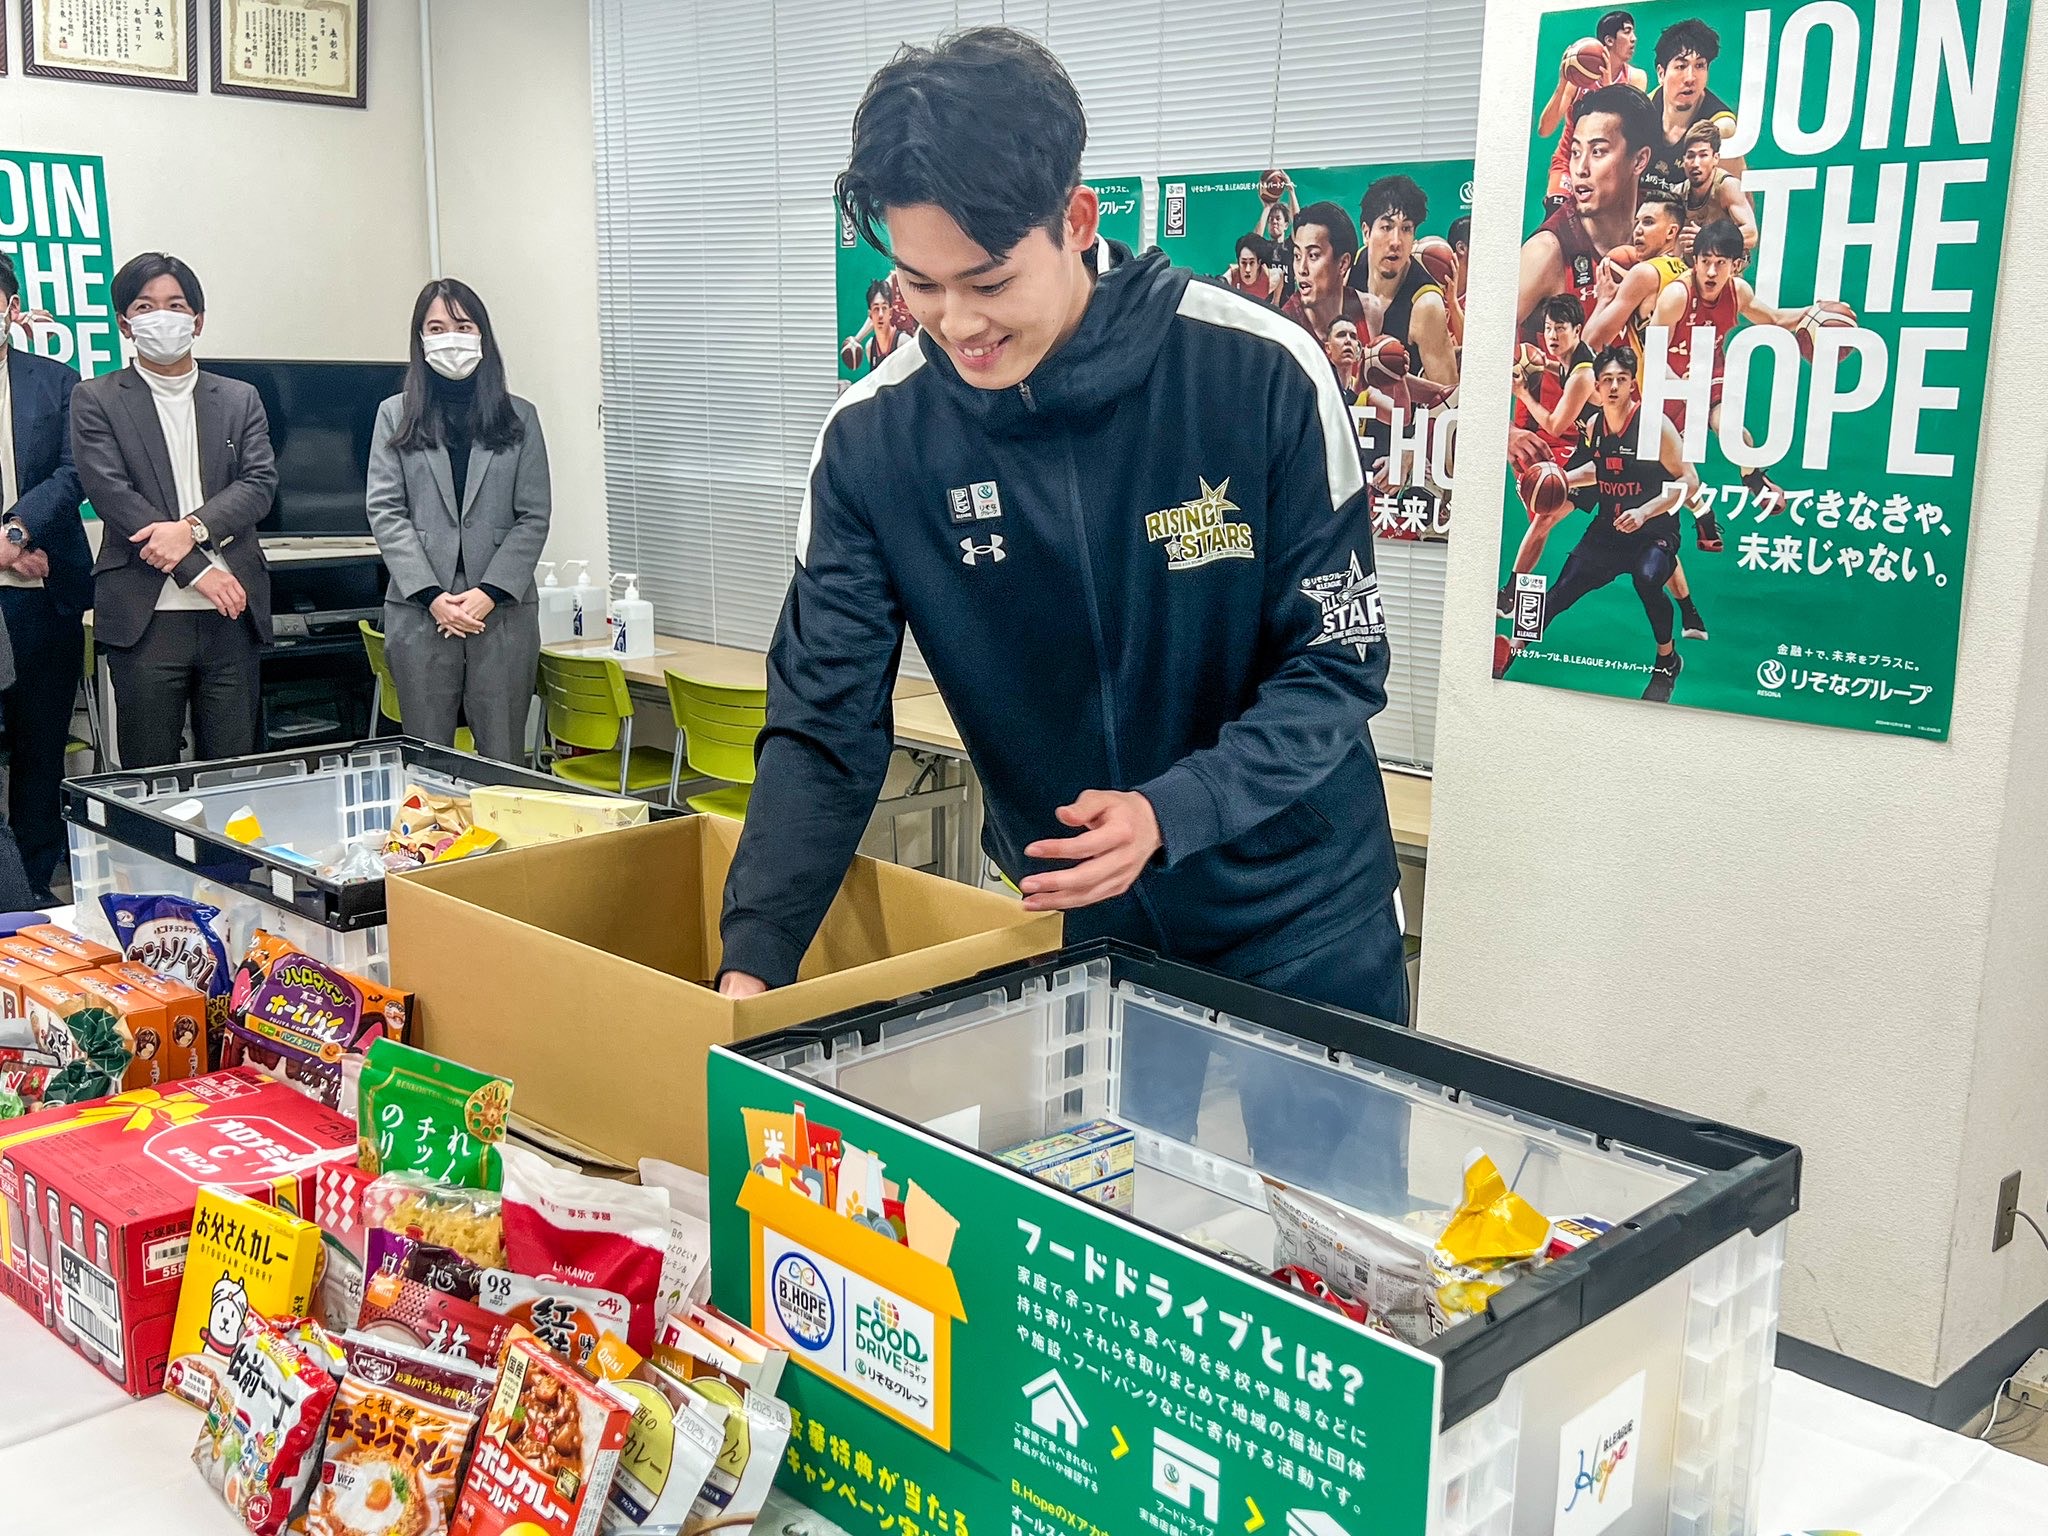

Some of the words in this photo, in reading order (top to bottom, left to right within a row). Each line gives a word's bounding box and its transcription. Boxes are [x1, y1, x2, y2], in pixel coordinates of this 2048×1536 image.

[1719, 0, 2007, 159] JOIN
[1740, 158, 1989, 313] THE
[1636, 325, 1968, 477] HOPE
[1146, 501, 1217, 541] RISING
[1661, 480, 1951, 537] ワクワクできなきゃ、
[1180, 523, 1252, 559] STARS
[1737, 531, 1948, 588] 未来じゃない。
[1321, 594, 1340, 616] ALL
[1791, 668, 1933, 705] りそなグループ
[207, 1144, 246, 1159] C
[196, 1206, 289, 1266] お父さんカレー
[243, 1262, 273, 1284] CURRY
[486, 1274, 512, 1297] 98
[778, 1278, 827, 1321] B.HOPE
[792, 1306, 813, 1322] ACTION
[855, 1302, 929, 1364] FOOD
[855, 1330, 903, 1373] DRIVE
[358, 1357, 392, 1376] NISSIN
[598, 1347, 625, 1374] Onisi
[660, 1354, 685, 1375] Onisi
[1016, 1264, 1367, 1449] 家庭で余っている食べ物を学校や職場などに
[867, 1366, 928, 1408] りそなグループ
[1016, 1293, 1366, 1482] 持ち寄り、それらを取りまとめて地域の福祉団体
[1016, 1323, 1361, 1515] や施設、フードバンクなどに寄付する活動です。
[330, 1408, 455, 1474] チキンラーメン
[1014, 1421, 1098, 1476] ご家庭で食べきれない
[337, 1471, 356, 1485] WFP
[1013, 1437, 1099, 1494] 食品がないか確認する
[467, 1466, 521, 1515] ゴールド
